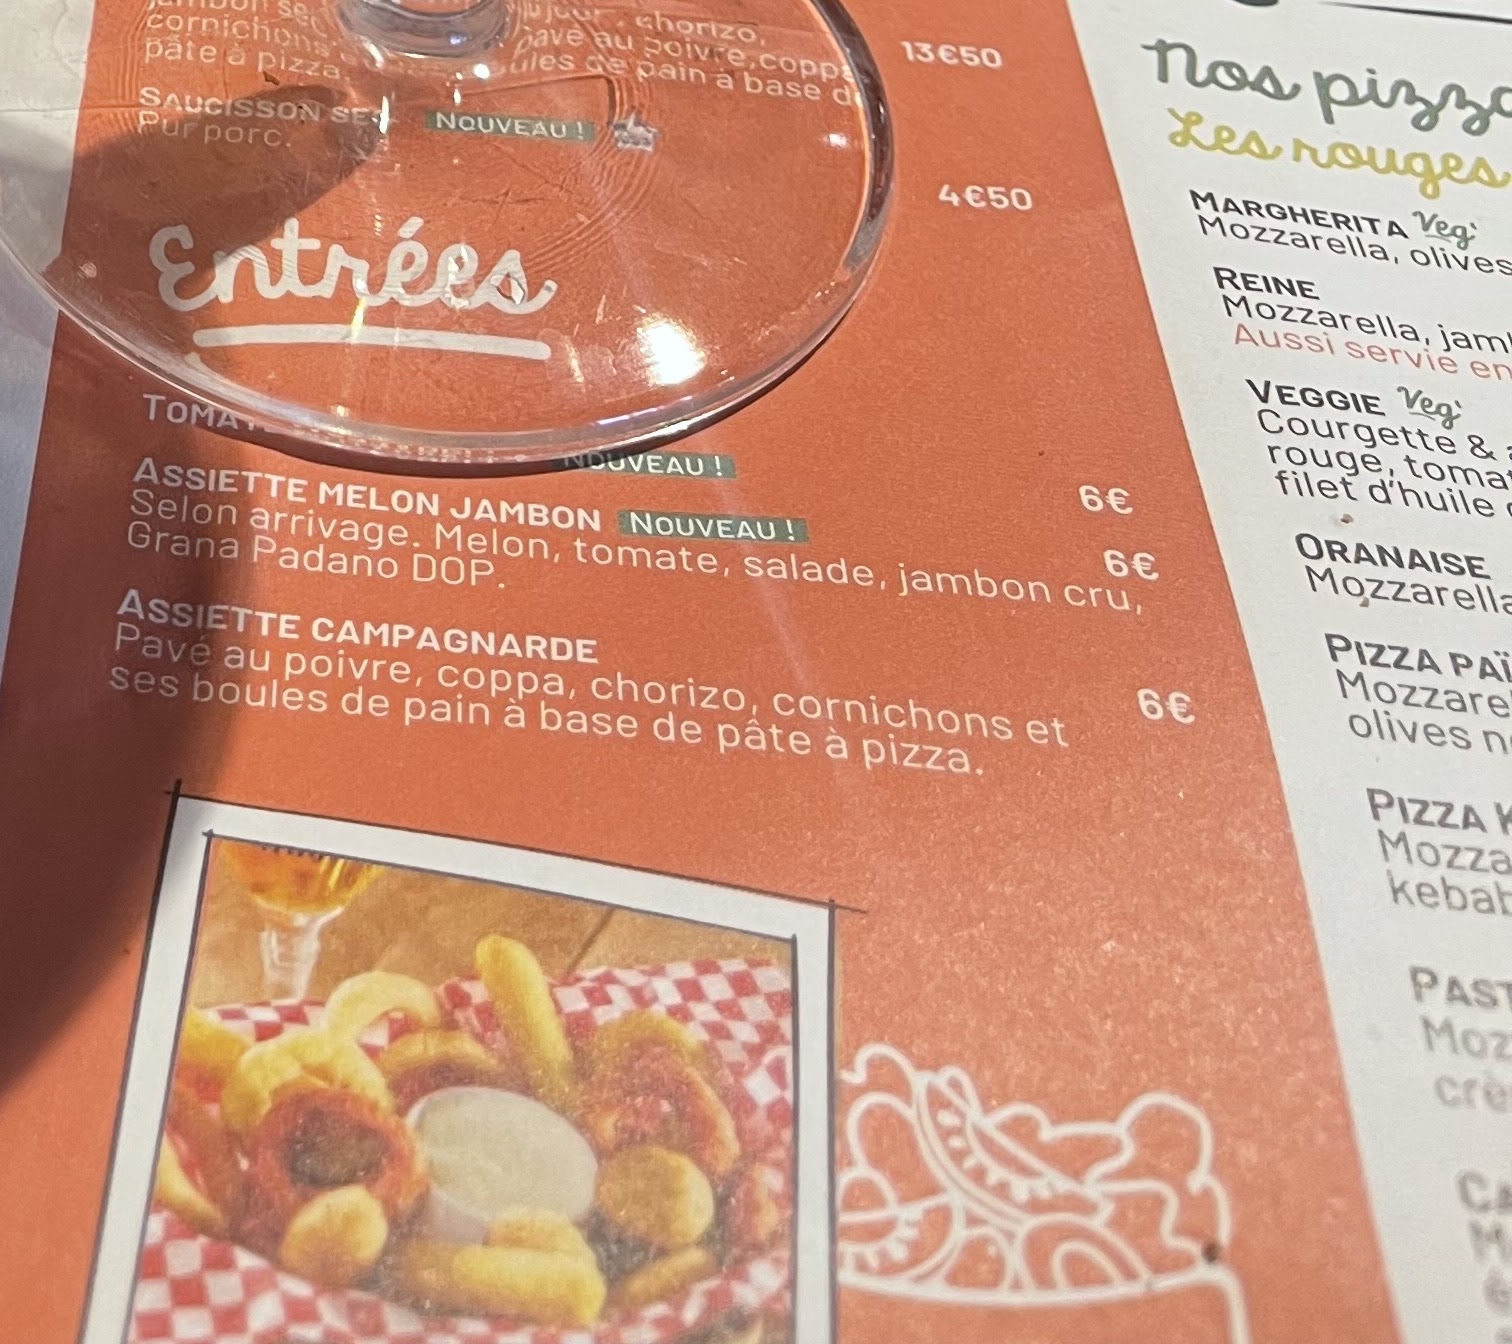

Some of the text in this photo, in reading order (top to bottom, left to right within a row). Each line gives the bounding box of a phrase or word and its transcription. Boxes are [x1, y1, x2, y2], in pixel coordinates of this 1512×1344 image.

[899, 40, 1004, 70] 13€50
[1140, 38, 1301, 101] Nos
[1291, 136, 1512, 201] rouges
[937, 183, 1034, 212] 4€50
[1189, 189, 1410, 240] MARGHERITA
[148, 215, 559, 316] Entrées
[1213, 266, 1320, 300] REINE
[1234, 322, 1458, 374] Aussi servie
[1245, 378, 1386, 417] VEGGIE
[1257, 408, 1498, 461] Courgette &
[133, 456, 1134, 541] ASSIETTE MELON JAMBON NOUVEAU 6€
[1274, 470, 1496, 518] filet d'huile
[127, 521, 399, 580] Grana Padano
[130, 489, 238, 526] Selon
[897, 562, 1052, 604] jambon
[1102, 549, 1160, 581] 6€
[1294, 532, 1492, 580] ORANAISE
[117, 588, 600, 664] ASSIETTE CAMPAGNARDE
[1323, 632, 1443, 675] PIZZA
[108, 666, 179, 698] ses
[192, 672, 329, 713] boules
[340, 685, 390, 718] de
[403, 692, 491, 726] pain
[539, 700, 639, 738] base
[652, 710, 703, 744] de
[717, 718, 813, 756] pâte
[115, 621, 1197, 750] Pavé au cornichons et 6€
[1348, 709, 1472, 751] olives
[1366, 787, 1489, 834] PIZZA
